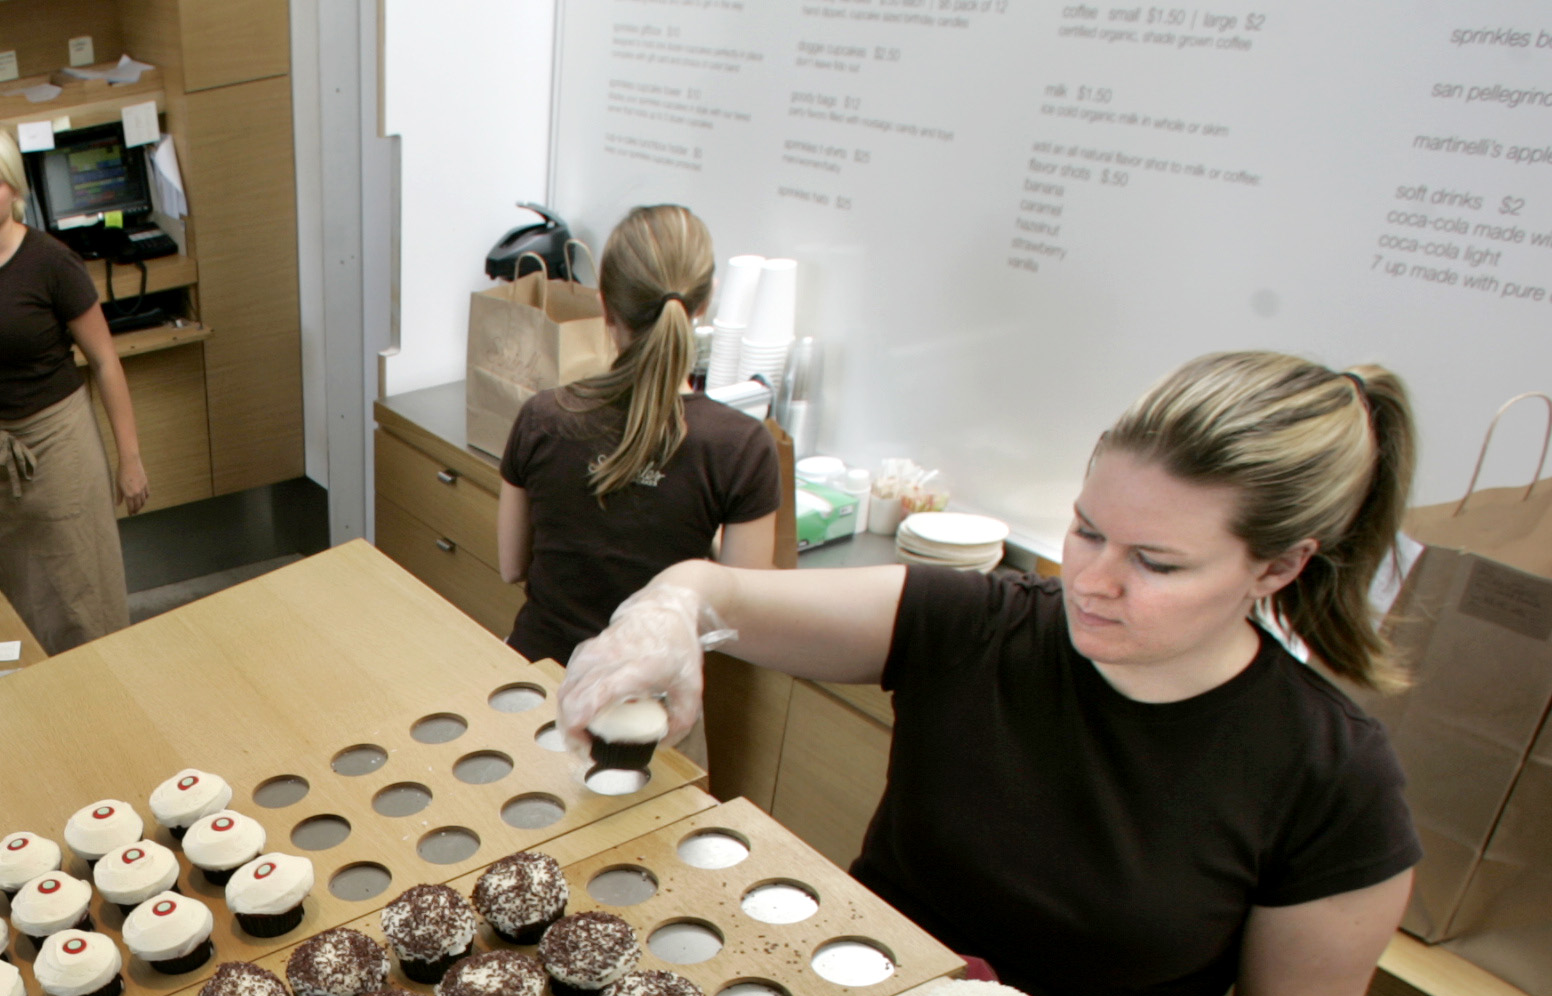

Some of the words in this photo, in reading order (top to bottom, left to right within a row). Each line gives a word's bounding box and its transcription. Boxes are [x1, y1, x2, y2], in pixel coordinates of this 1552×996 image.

[1062, 4, 1098, 19] coffee
[1108, 7, 1142, 22] small
[1147, 6, 1186, 25] $1.50
[1203, 12, 1238, 32] large
[1245, 12, 1266, 31] $2
[1142, 32, 1176, 45] shade
[1177, 35, 1213, 49] grown
[1216, 36, 1252, 51] coffee
[1450, 28, 1531, 48] sprinkles
[1045, 84, 1067, 97] milk
[1077, 85, 1113, 104] $1.50
[1431, 83, 1463, 98] san
[1153, 118, 1185, 132] whole
[1187, 123, 1200, 134] or
[1202, 124, 1229, 136] skim
[1412, 135, 1502, 158] martinelli's
[1028, 157, 1057, 174] flavor
[1061, 165, 1091, 181] shots
[1144, 158, 1169, 171] shot
[1170, 161, 1182, 174] to
[1183, 164, 1206, 176] milk
[1208, 169, 1222, 179] or
[1023, 178, 1064, 197] banana
[1020, 199, 1063, 217] caramel
[1395, 185, 1428, 201] soft
[1430, 189, 1483, 210] drinks
[1498, 195, 1525, 216] $2
[1386, 210, 1469, 235] coca-cola
[1473, 224, 1526, 244] made
[1011, 237, 1067, 261] strawberry
[1378, 234, 1460, 259] coca-cola
[1464, 246, 1502, 267] light
[1371, 254, 1383, 270] 7
[1385, 262, 1407, 277] up
[1410, 266, 1458, 285] made
[1463, 276, 1499, 292] with
[1500, 282, 1546, 301] pure
